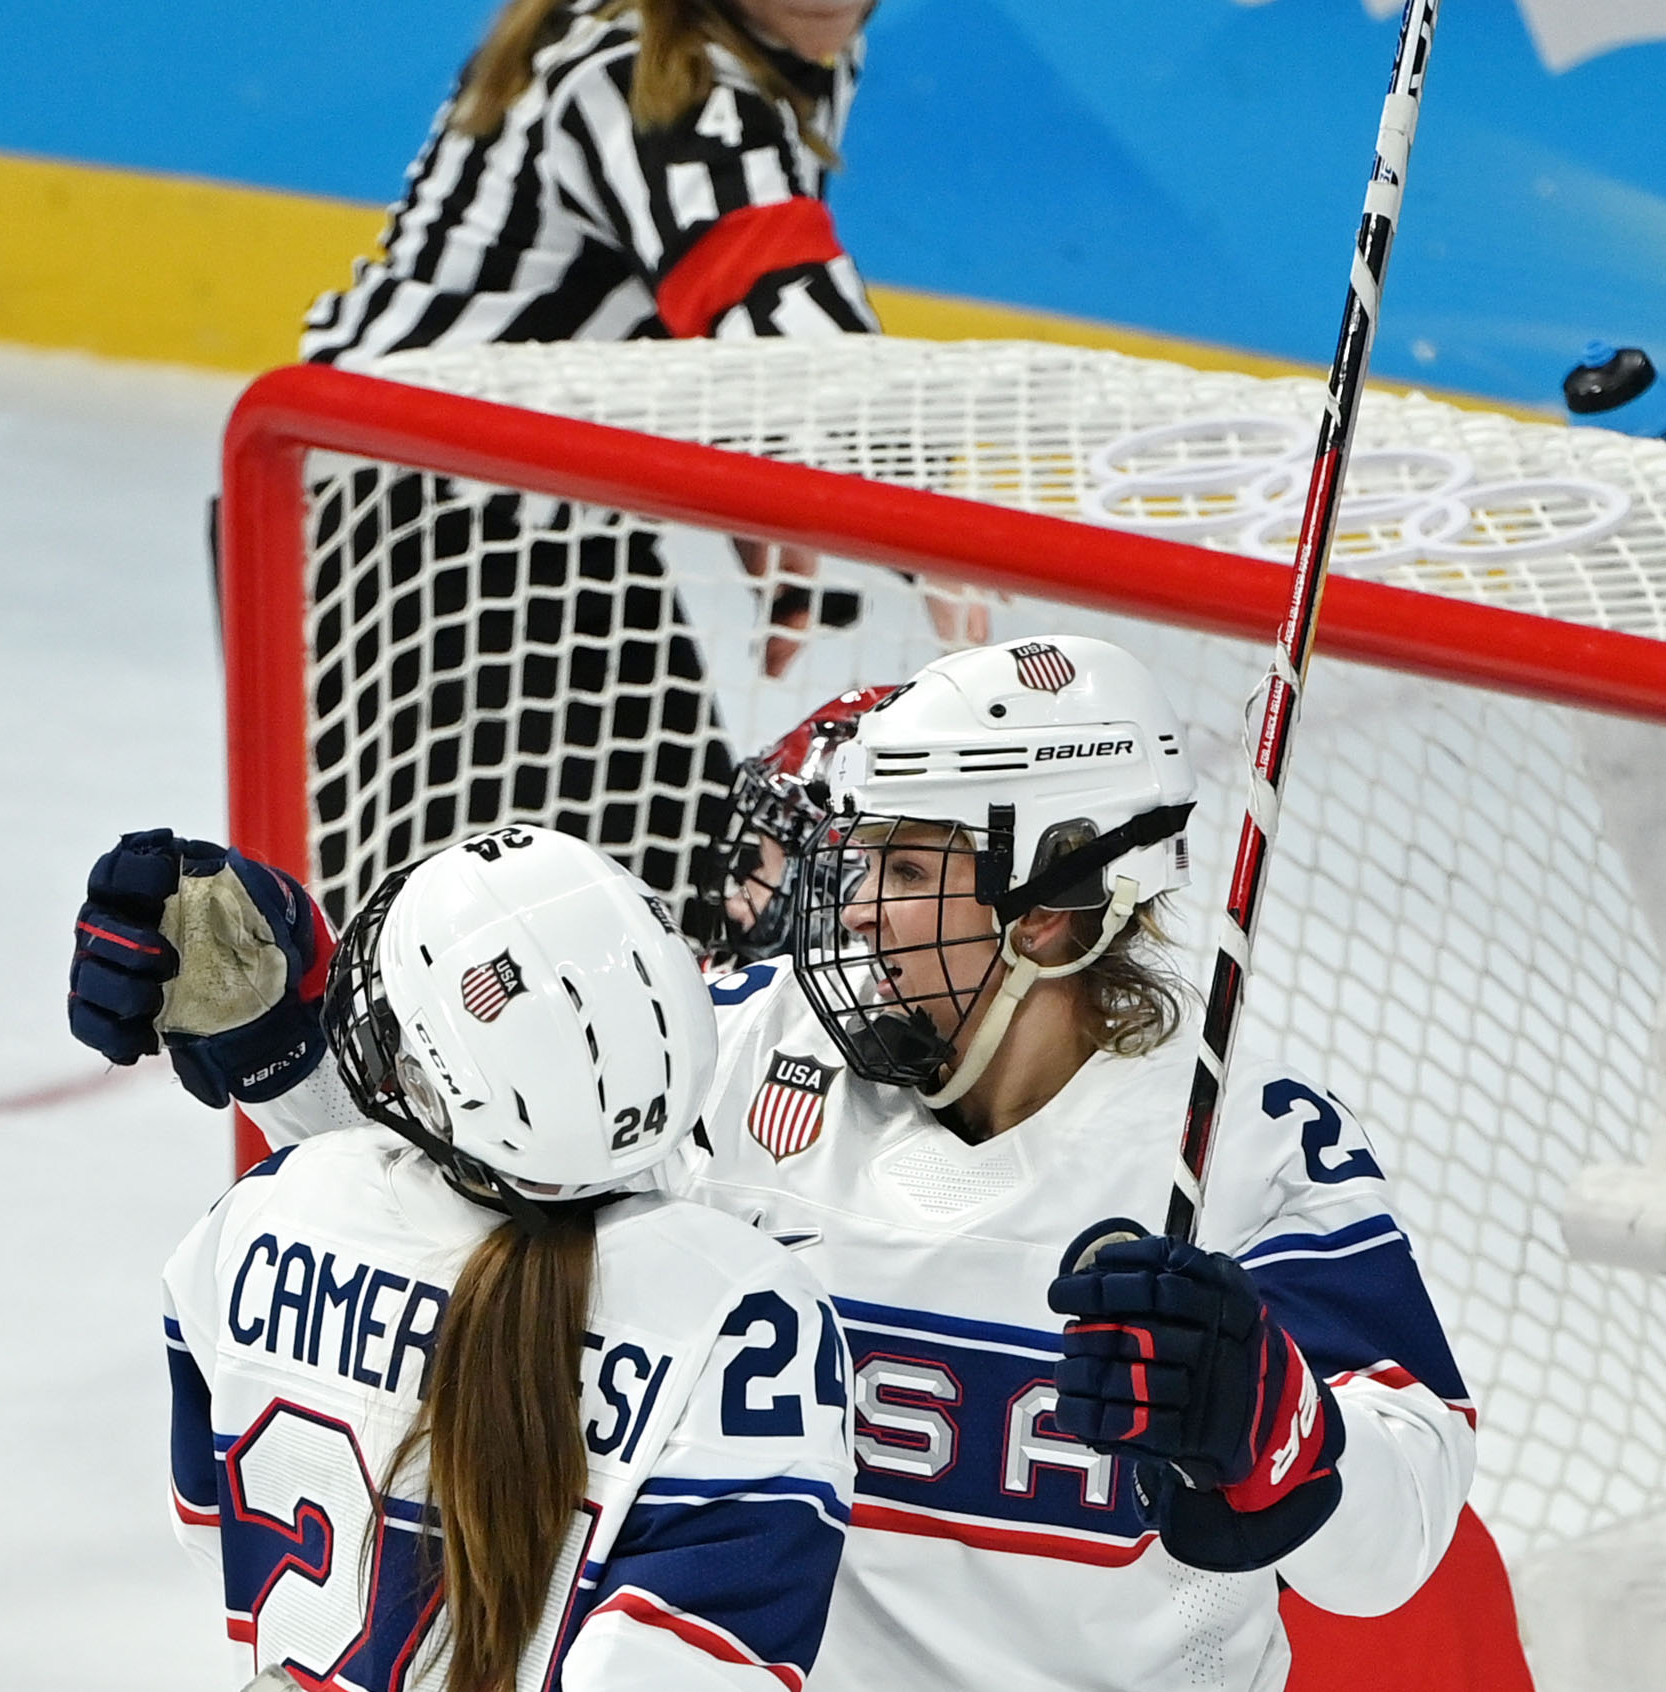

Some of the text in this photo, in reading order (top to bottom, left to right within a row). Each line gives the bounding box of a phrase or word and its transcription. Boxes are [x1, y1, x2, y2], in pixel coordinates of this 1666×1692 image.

[697, 87, 742, 147] 4
[1015, 640, 1050, 661] USA
[1034, 736, 1136, 763] BAUER
[463, 826, 534, 863] 24
[494, 957, 520, 993] USA
[414, 1022, 463, 1096] CCM
[775, 1055, 824, 1091] USA
[610, 1092, 669, 1152] 24
[1261, 1078, 1388, 1185] 2
[854, 1351, 1120, 1511] SA
